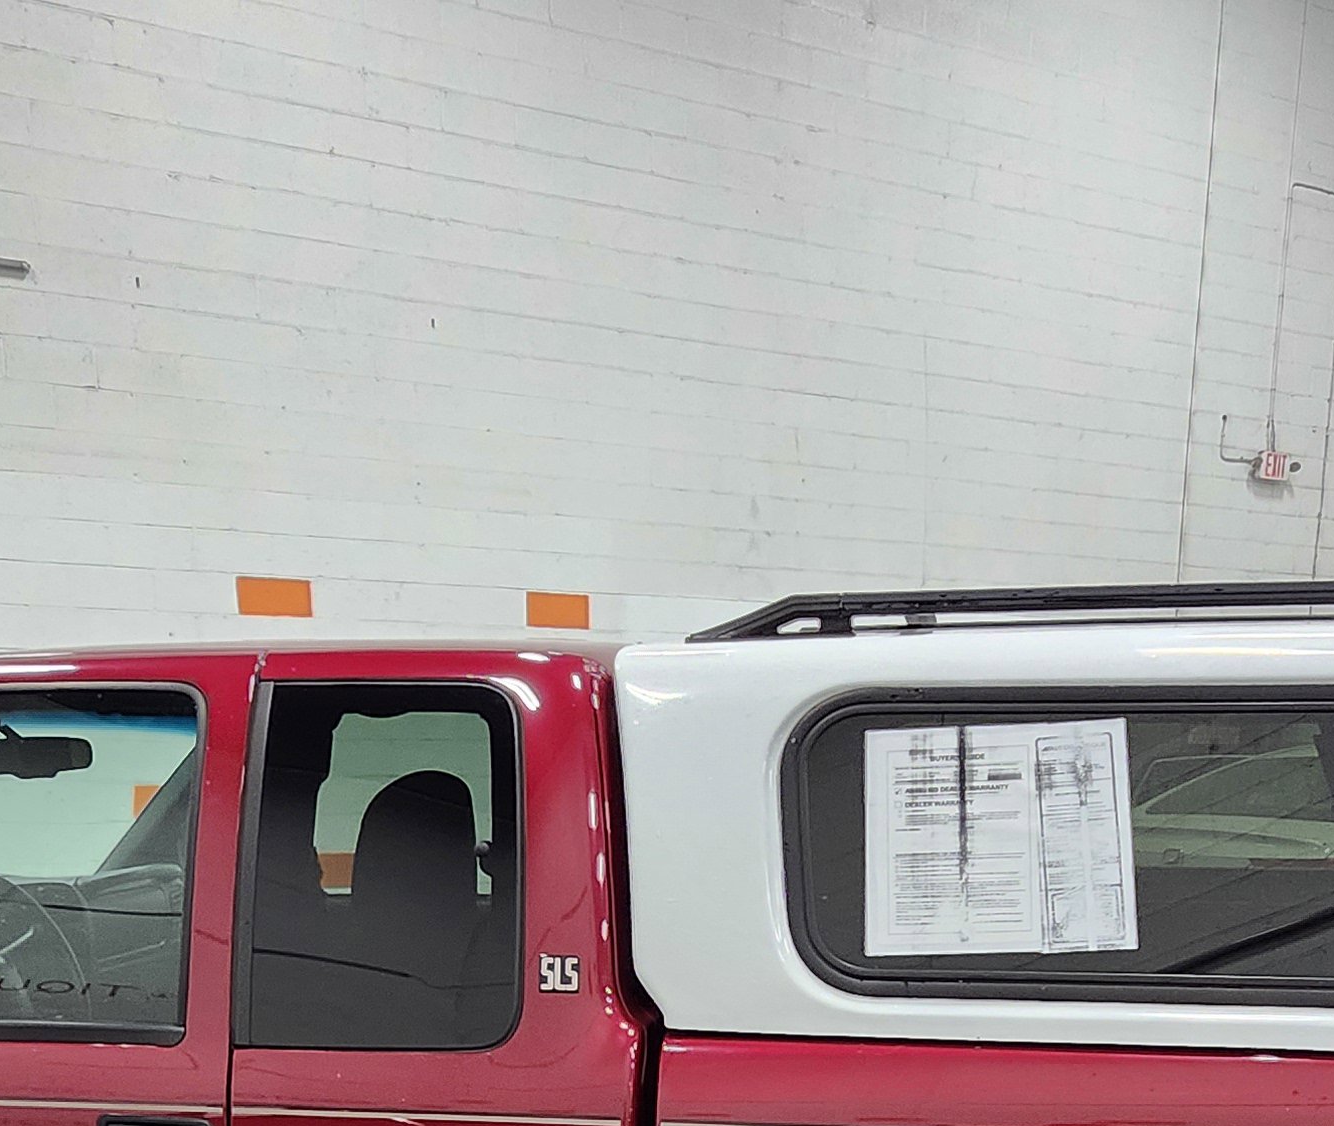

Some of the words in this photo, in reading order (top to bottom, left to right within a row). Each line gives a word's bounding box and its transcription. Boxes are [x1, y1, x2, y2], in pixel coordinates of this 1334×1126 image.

[1265, 453, 1287, 478] EXIT
[934, 799, 975, 807] WARRANY
[539, 955, 579, 992] SLS
